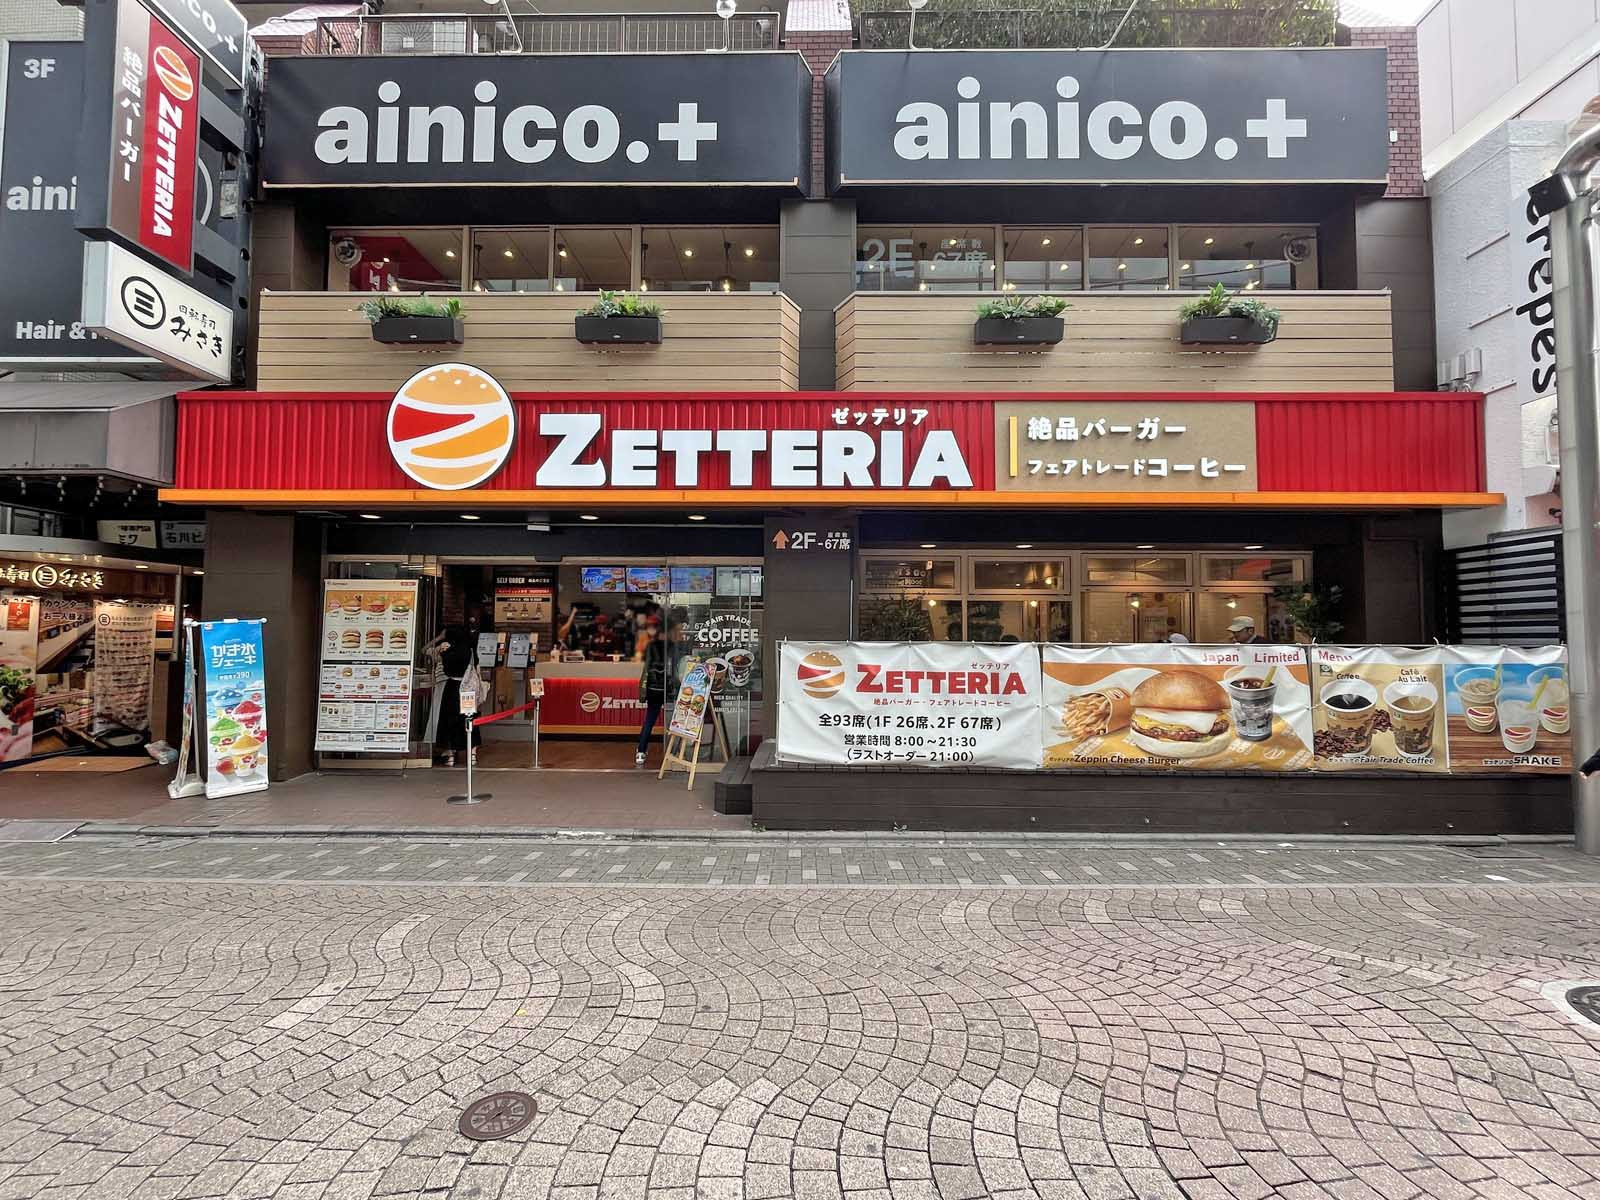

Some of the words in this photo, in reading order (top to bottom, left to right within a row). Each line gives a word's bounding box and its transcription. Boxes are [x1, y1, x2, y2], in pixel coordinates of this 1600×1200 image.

[23, 58, 56, 78] 3F
[120, 46, 143, 182] 絶品バーガー
[153, 92, 183, 237] ZETTERIA
[16, 320, 65, 340] Hair
[170, 315, 222, 358] みさき
[831, 407, 929, 426] ゼッテリア
[1027, 416, 1187, 441] 絶品バーガー
[535, 413, 974, 487] ZETTERIA
[1027, 456, 1247, 478] フェアトレードコーヒー
[706, 615, 724, 628] FAIR
[726, 614, 752, 627] TRADE
[699, 628, 759, 642] COFFEE
[212, 655, 257, 668] シェーキ
[970, 662, 1011, 670] ゼッテリア
[1203, 652, 1240, 665] Japan
[1254, 650, 1300, 664] Limited
[1318, 650, 1353, 662] Menu
[855, 663, 1027, 695] ZETTERIA
[844, 733, 891, 747] 営業時間
[1073, 754, 1109, 765] Zeppin
[1110, 755, 1146, 765] Cheese
[1148, 756, 1181, 767] Burger
[1359, 756, 1378, 764] Fair
[1379, 756, 1404, 764] Trade
[1405, 756, 1434, 765] Coffee
[1512, 755, 1561, 766] SHAKE
